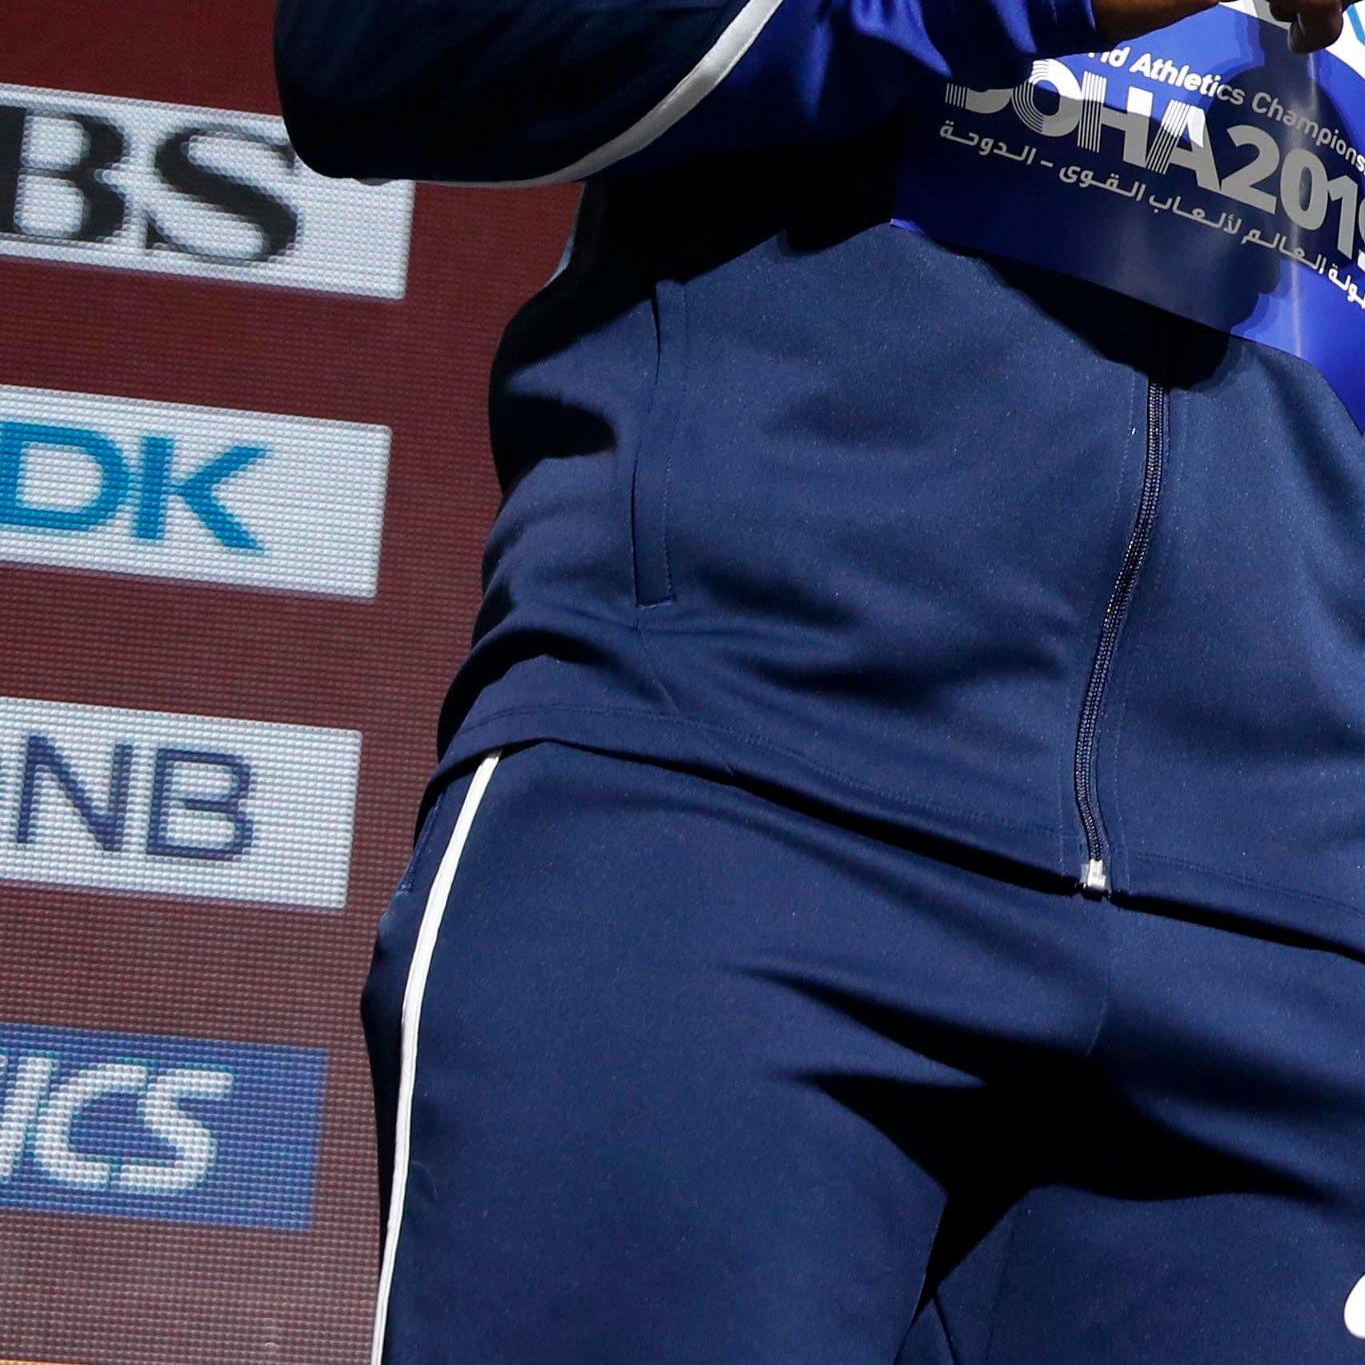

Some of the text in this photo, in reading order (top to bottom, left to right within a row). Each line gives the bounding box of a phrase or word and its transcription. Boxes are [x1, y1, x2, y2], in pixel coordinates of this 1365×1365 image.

[1128, 52, 1246, 106] Athletics
[939, 119, 1037, 166] الدوحة
[1241, 227, 1326, 276] العالم
[16, 734, 253, 862] NB
[0, 1051, 235, 1194] ICS
